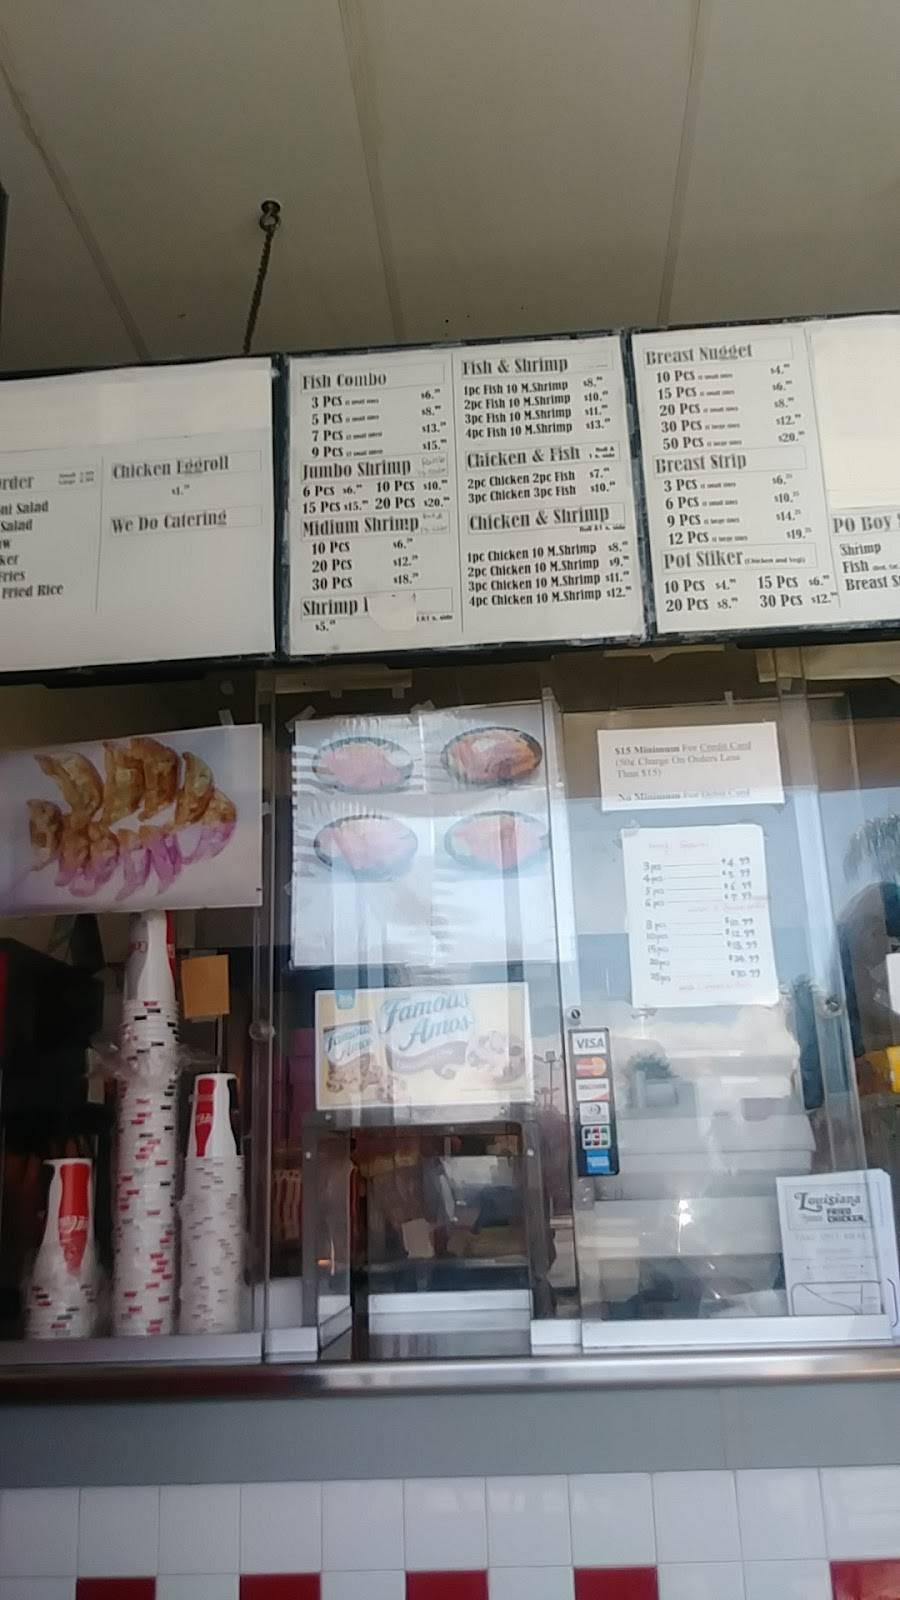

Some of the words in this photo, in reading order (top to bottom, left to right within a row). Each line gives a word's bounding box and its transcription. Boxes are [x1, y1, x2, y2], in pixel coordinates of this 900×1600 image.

[646, 349, 694, 365] Breast
[700, 344, 752, 361] Nugget
[463, 360, 492, 375] Fish
[497, 359, 509, 373] &
[515, 357, 568, 373] Shrimp
[303, 374, 331, 390] Fish
[337, 372, 386, 387] Combo
[656, 372, 670, 383] 10
[675, 370, 695, 381] Pcs
[464, 385, 480, 396] 1pc
[484, 384, 503, 394] Fish
[507, 384, 517, 393] 10
[522, 381, 568, 392] M.Shrimp
[658, 389, 671, 400] 15
[676, 387, 697, 398] Pcs
[312, 396, 318, 409] 3
[323, 396, 342, 407] Pcs
[464, 398, 482, 410] 2pc
[486, 398, 505, 409] Fish
[509, 398, 519, 407] 10
[524, 394, 570, 406] M.Shrimp
[465, 413, 483, 425] 3pc
[487, 412, 506, 422] Fish
[510, 412, 520, 421] 10
[524, 408, 571, 420] M.Shrimp
[659, 405, 675, 416] 20
[680, 403, 700, 415] Pcs
[312, 414, 319, 425] 5
[323, 413, 343, 424] Pcs
[465, 427, 484, 439] 4pc
[487, 426, 507, 437] Fish
[511, 426, 521, 436] 10
[525, 422, 572, 435] M.Shrimp
[661, 421, 676, 433] 30
[681, 420, 702, 431] Pcs
[312, 430, 319, 442] 7
[323, 430, 343, 441] Pcs
[663, 438, 678, 450] 50
[683, 437, 704, 448] Pcs
[312, 447, 319, 458] 9
[324, 447, 343, 457] Pcs
[467, 452, 526, 468] Chicken
[532, 449, 544, 463] &
[550, 446, 580, 461] Fish
[112, 461, 171, 480] Chicken
[177, 456, 229, 475] Eggroll
[656, 455, 705, 473] Breast
[710, 453, 746, 469] Strip
[303, 463, 352, 481] Jumbo
[358, 460, 411, 476] Shrimp
[377, 481, 390, 492] 10
[395, 480, 415, 491] Pcs
[468, 478, 486, 490] 2pc
[489, 474, 529, 486] Chicken
[533, 473, 550, 484] 2pc
[555, 471, 575, 481] Fish
[664, 480, 672, 492] 3
[677, 479, 697, 491] Pcs
[303, 487, 310, 497] 6
[315, 486, 334, 496] Pcs
[468, 492, 487, 504] 3pc
[490, 488, 530, 501] Chicken
[534, 487, 552, 498] 3pc
[556, 485, 576, 496] Fish
[17, 501, 49, 514] Salad
[303, 502, 316, 514] 15
[321, 501, 340, 513] Pcs
[375, 498, 390, 509] 20
[396, 497, 415, 508] Pcs
[666, 498, 673, 509] 6
[678, 496, 699, 508] Pcs
[112, 517, 133, 534] We
[139, 517, 158, 531] Do
[164, 510, 227, 529] Catering
[470, 513, 530, 530] Chicken
[536, 512, 548, 525] &
[554, 507, 609, 524] Shrimp
[667, 515, 675, 527] 9
[680, 514, 701, 526] Pcs
[833, 517, 855, 533] PO
[861, 516, 891, 531] Boy
[1, 521, 33, 532] Salad
[304, 519, 359, 537] Midium
[365, 517, 419, 533] Shrimp
[669, 533, 683, 545] 12
[688, 532, 709, 543] Pcs
[312, 542, 325, 555] 10
[330, 541, 350, 553] Pcs
[468, 552, 484, 563] 1pc
[488, 550, 528, 561] Chicken
[532, 548, 543, 558] 10
[548, 544, 596, 556] M.Shrimp
[840, 543, 881, 556] Shrimp
[312, 560, 327, 573] 20
[332, 559, 352, 571] Pcs
[664, 553, 690, 569] Pot
[696, 550, 744, 567] Stiker
[843, 560, 869, 573] Fish
[468, 567, 486, 578] 2pc
[490, 564, 531, 576] Chicken
[535, 562, 546, 572] 10
[550, 559, 599, 571] M.Shrimp
[312, 578, 327, 591] 30
[333, 577, 352, 589] Pcs
[468, 582, 487, 593] 3pc
[491, 579, 532, 590] Chicken
[536, 578, 547, 587] 10
[551, 573, 600, 587] M.Shrimp
[665, 580, 678, 594] 10
[684, 579, 705, 592] Pcs
[758, 576, 772, 589] 15
[777, 575, 798, 588] Pcs
[846, 576, 887, 590] Breast
[2, 586, 33, 599] Fried
[38, 584, 63, 596] Rice
[468, 596, 488, 608] 4pc
[492, 594, 532, 605] Chicken
[537, 592, 548, 603] 10
[552, 589, 601, 602] M.Shrimp
[303, 599, 357, 616] Shrimp
[666, 599, 682, 612] 20
[688, 598, 708, 611] Pcs
[760, 595, 776, 608] 30
[781, 594, 802, 607] Pcs
[615, 747, 631, 755] $15
[634, 745, 679, 754] Minimum
[381, 989, 469, 1032] Famous
[399, 1013, 473, 1050] Amos
[577, 1038, 604, 1049] VISA
[794, 1192, 860, 1212] Louisiana
